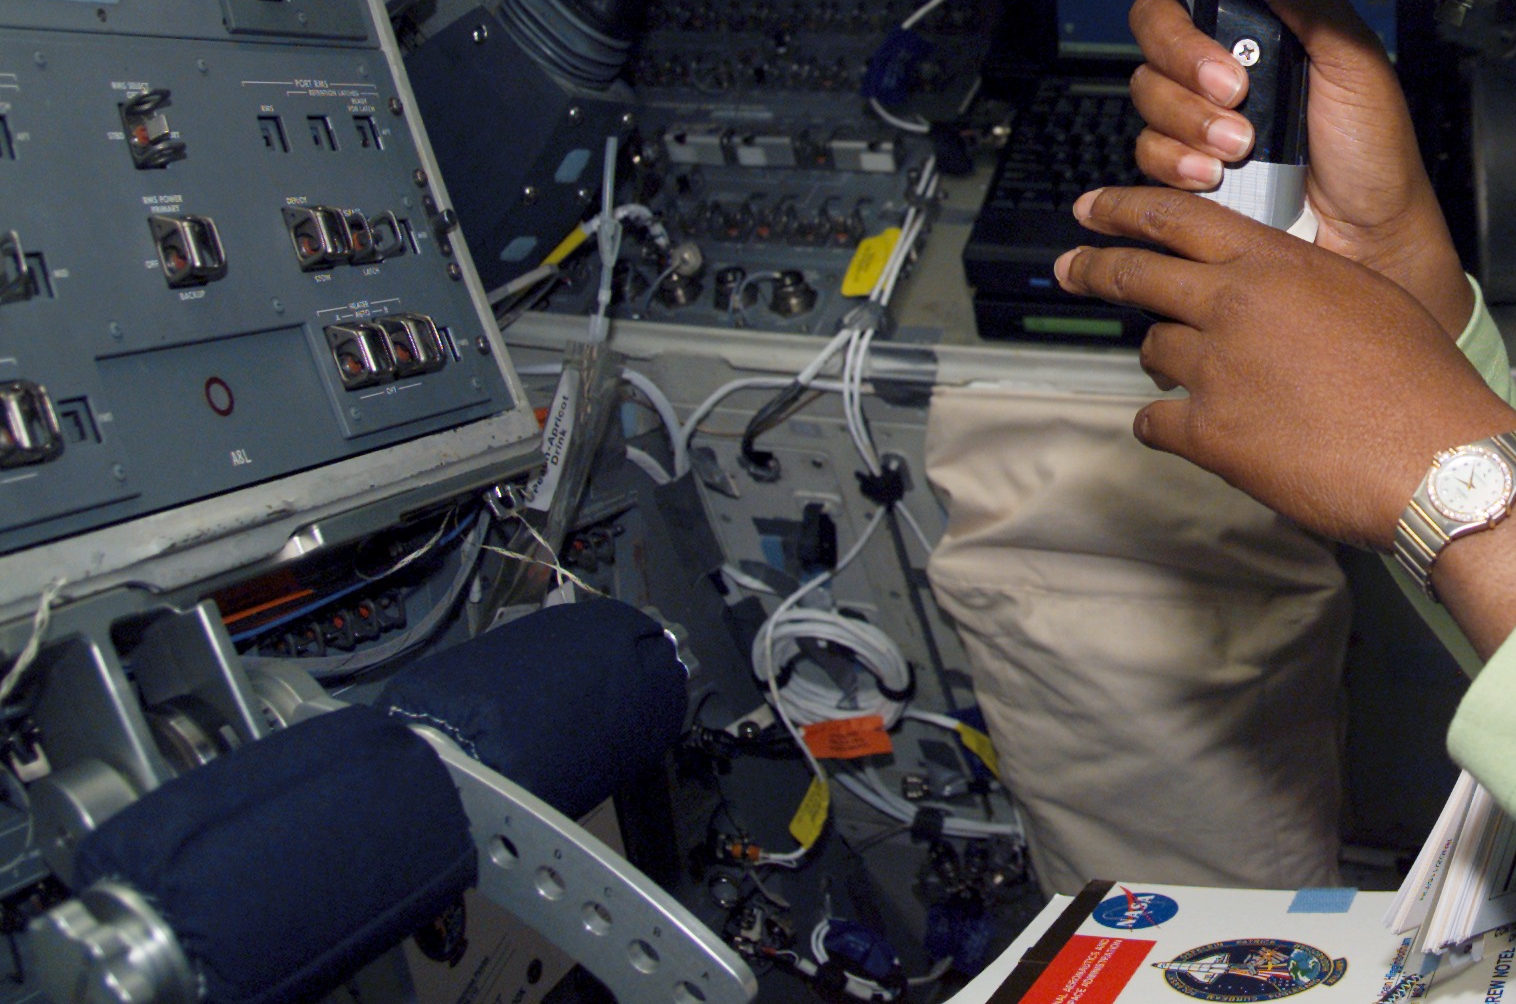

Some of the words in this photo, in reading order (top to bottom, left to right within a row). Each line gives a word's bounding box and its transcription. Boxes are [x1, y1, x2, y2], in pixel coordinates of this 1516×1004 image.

[532, 395, 569, 494] Peah-Apricot
[550, 428, 568, 466] Drink
[1116, 895, 1155, 927] NASA
[1065, 951, 1097, 993] AERONAUTICS
[1095, 939, 1109, 953] AND
[1082, 939, 1124, 988] ADMINISTRATION
[1485, 970, 1507, 1004] REW
